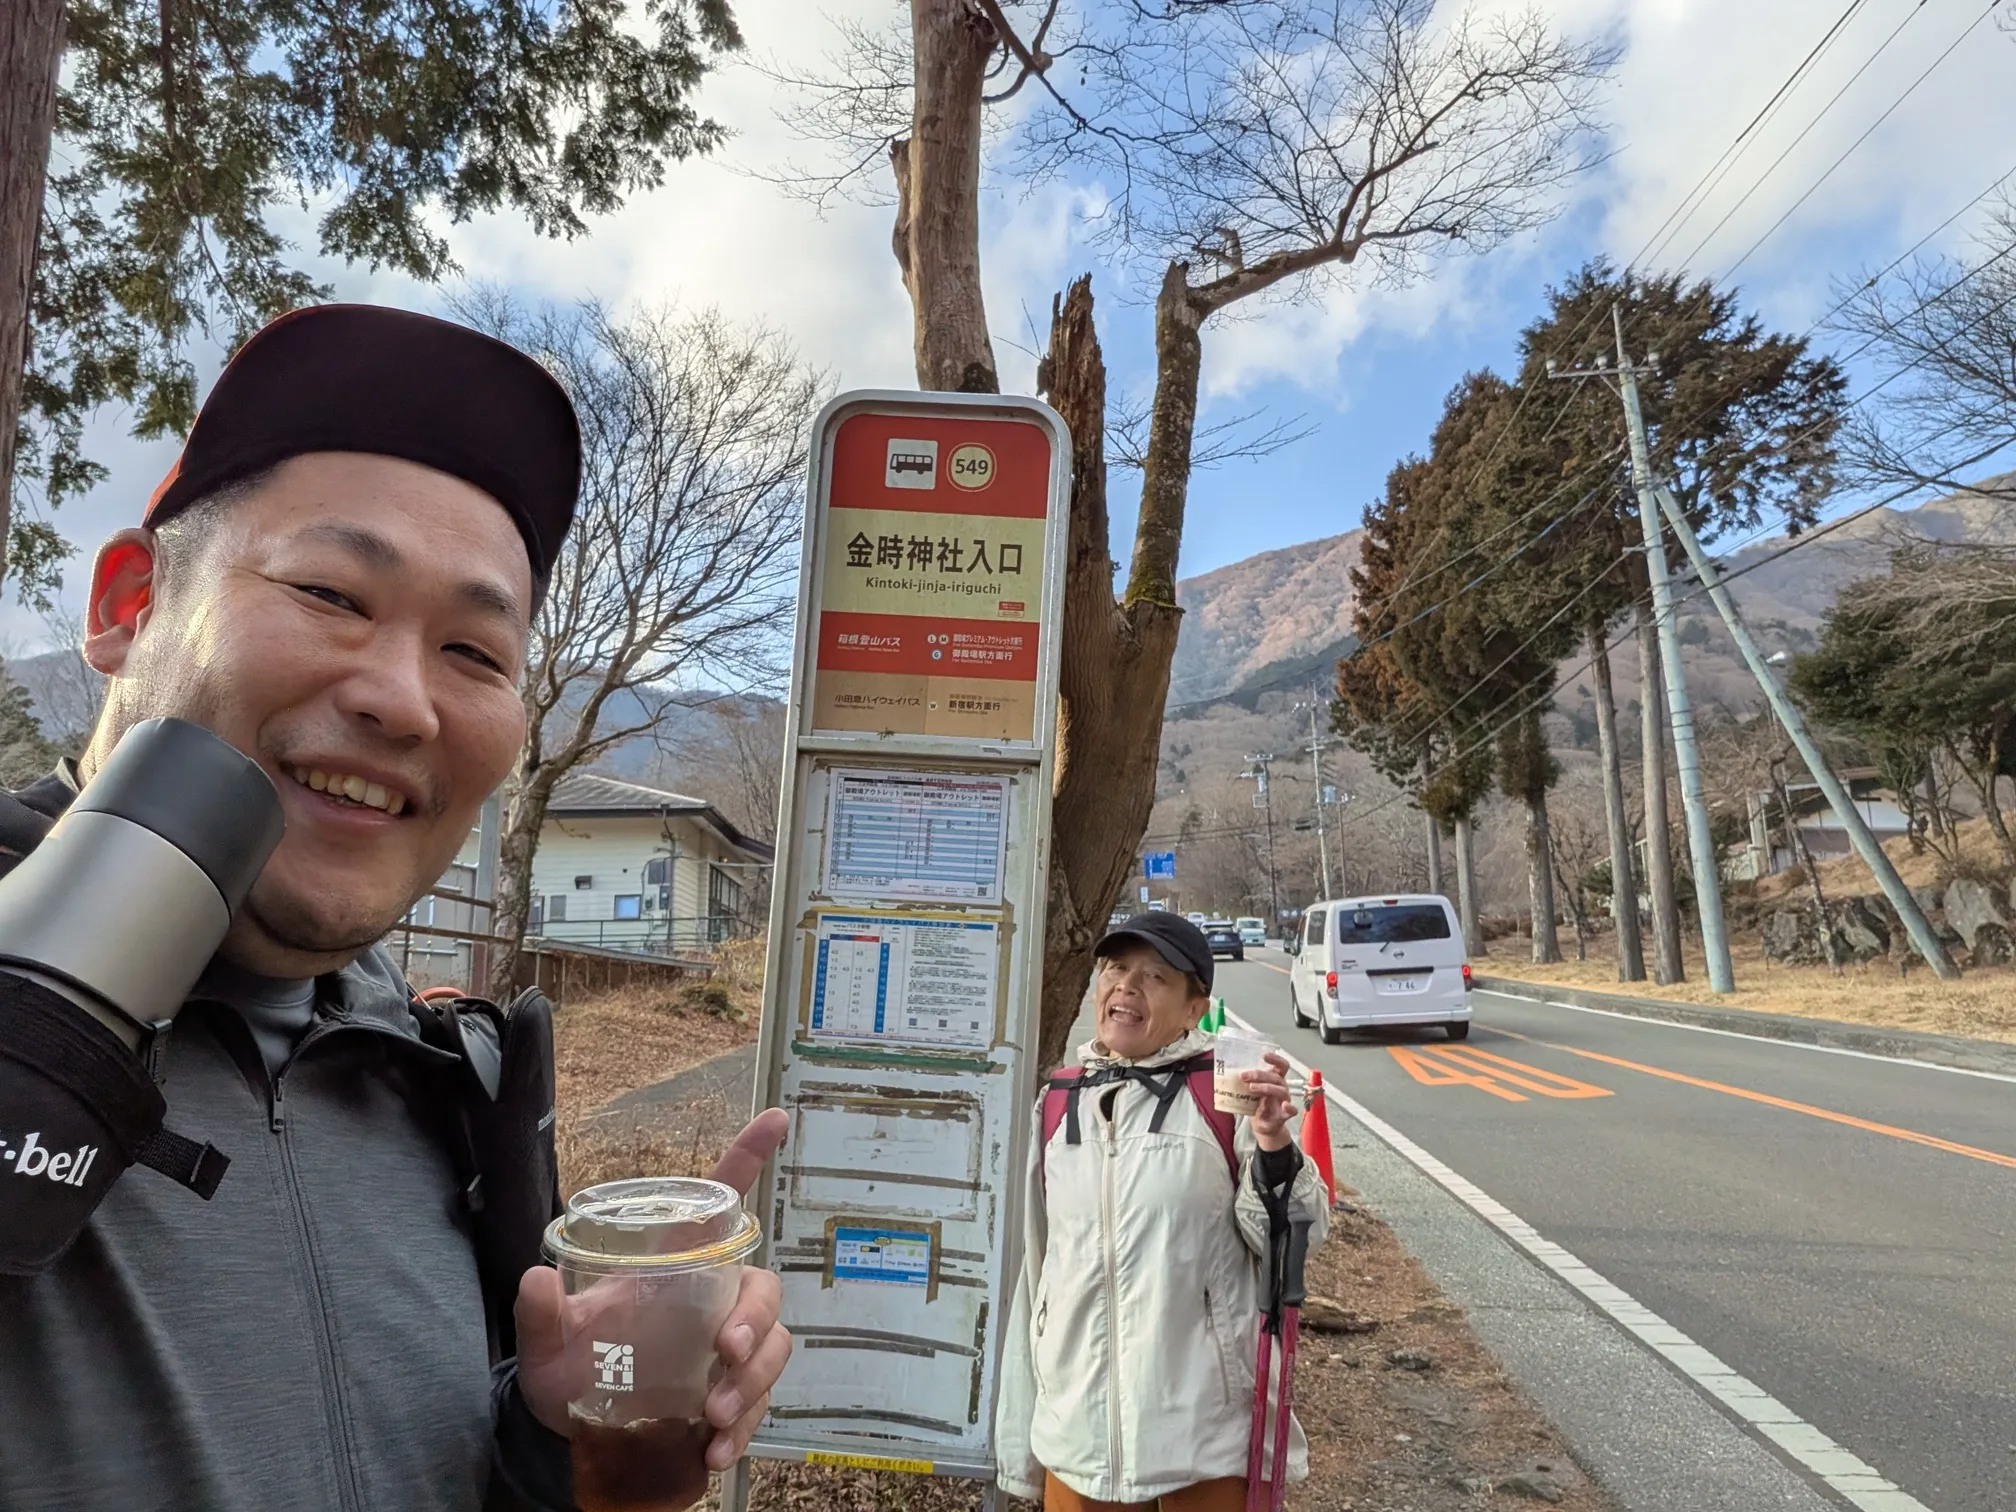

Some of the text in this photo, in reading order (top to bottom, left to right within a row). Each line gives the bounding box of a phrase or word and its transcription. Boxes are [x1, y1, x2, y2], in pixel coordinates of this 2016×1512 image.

[955, 459, 989, 475] 549
[846, 531, 1023, 575] 金時神社入口
[866, 577, 1002, 595] Kintoki-jinja-iriguchi
[838, 633, 901, 647] 箱根登山バス
[952, 649, 1013, 661] 御殿場駅方面行
[835, 695, 920, 706] 小田急ハイウェイバス
[949, 700, 1001, 711] 新宿駅方面行
[1386, 1044, 1615, 1102] 40
[0, 1131, 99, 1187] -bell
[595, 1381, 615, 1391] SEVEN
